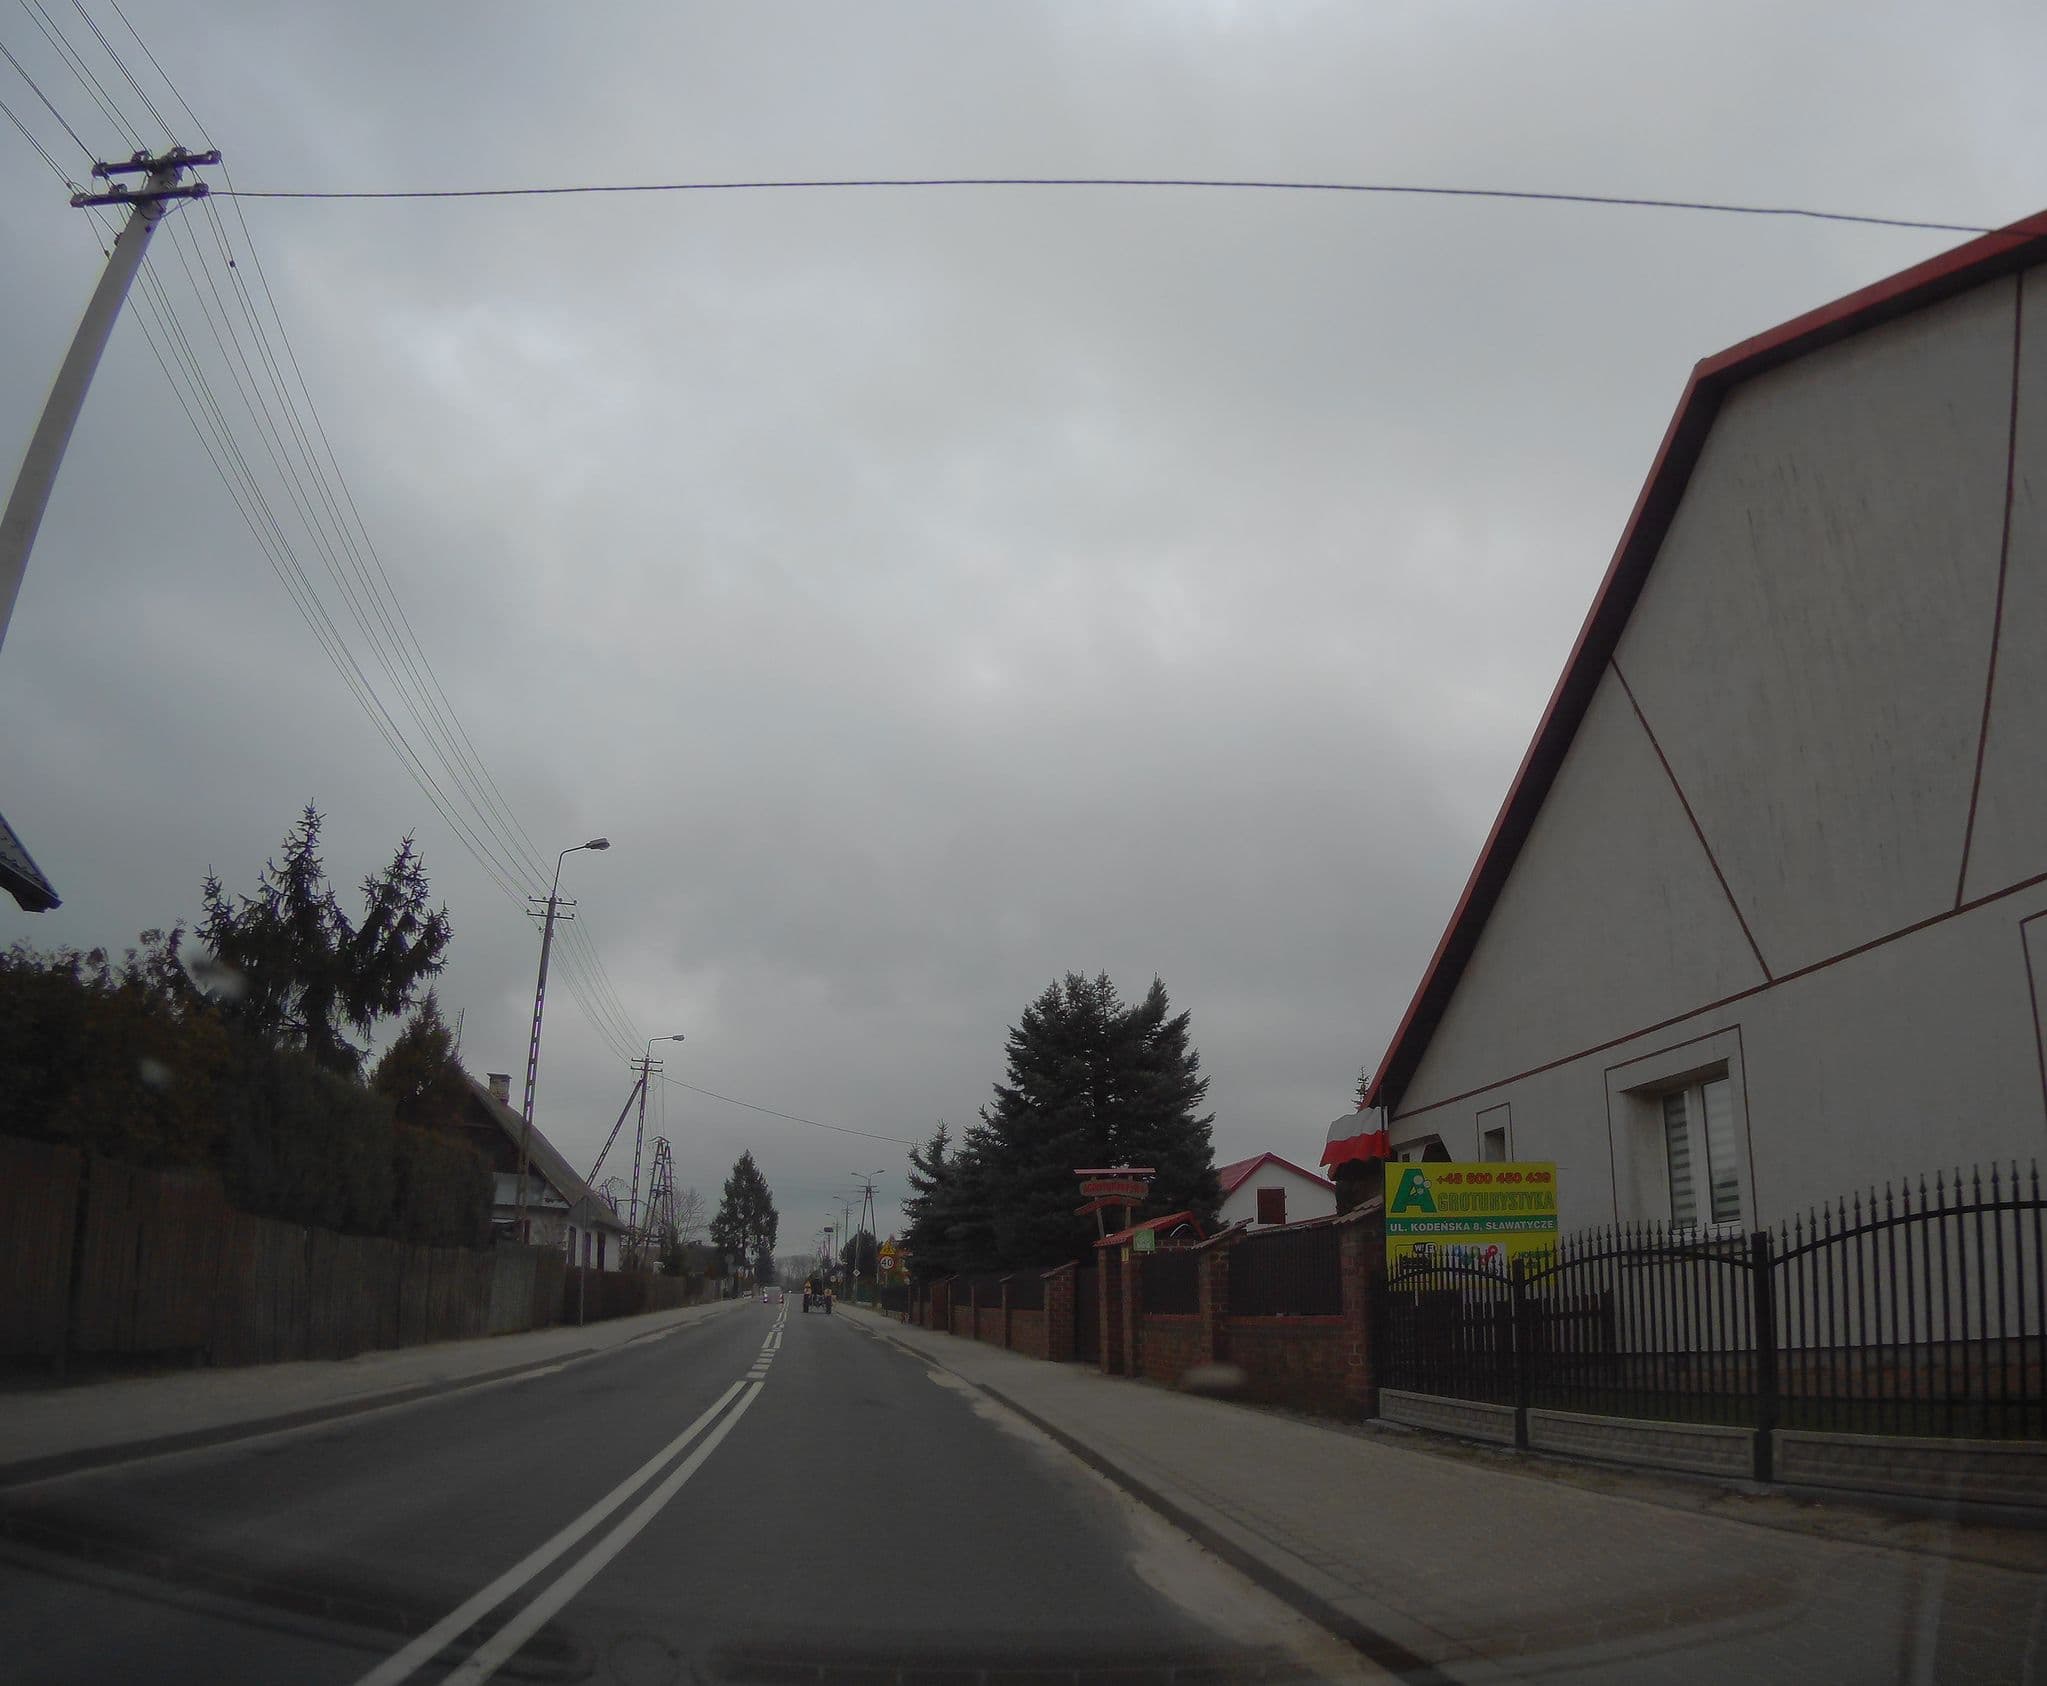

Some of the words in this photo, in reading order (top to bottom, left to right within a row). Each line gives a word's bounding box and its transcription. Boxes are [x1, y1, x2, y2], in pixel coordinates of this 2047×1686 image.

[1390, 1222, 1407, 1232] UL.
[1410, 1220, 1470, 1232] KODEŃSKA
[1485, 1219, 1554, 1230] SŁAWATYCZE
[881, 1258, 893, 1267] 40
